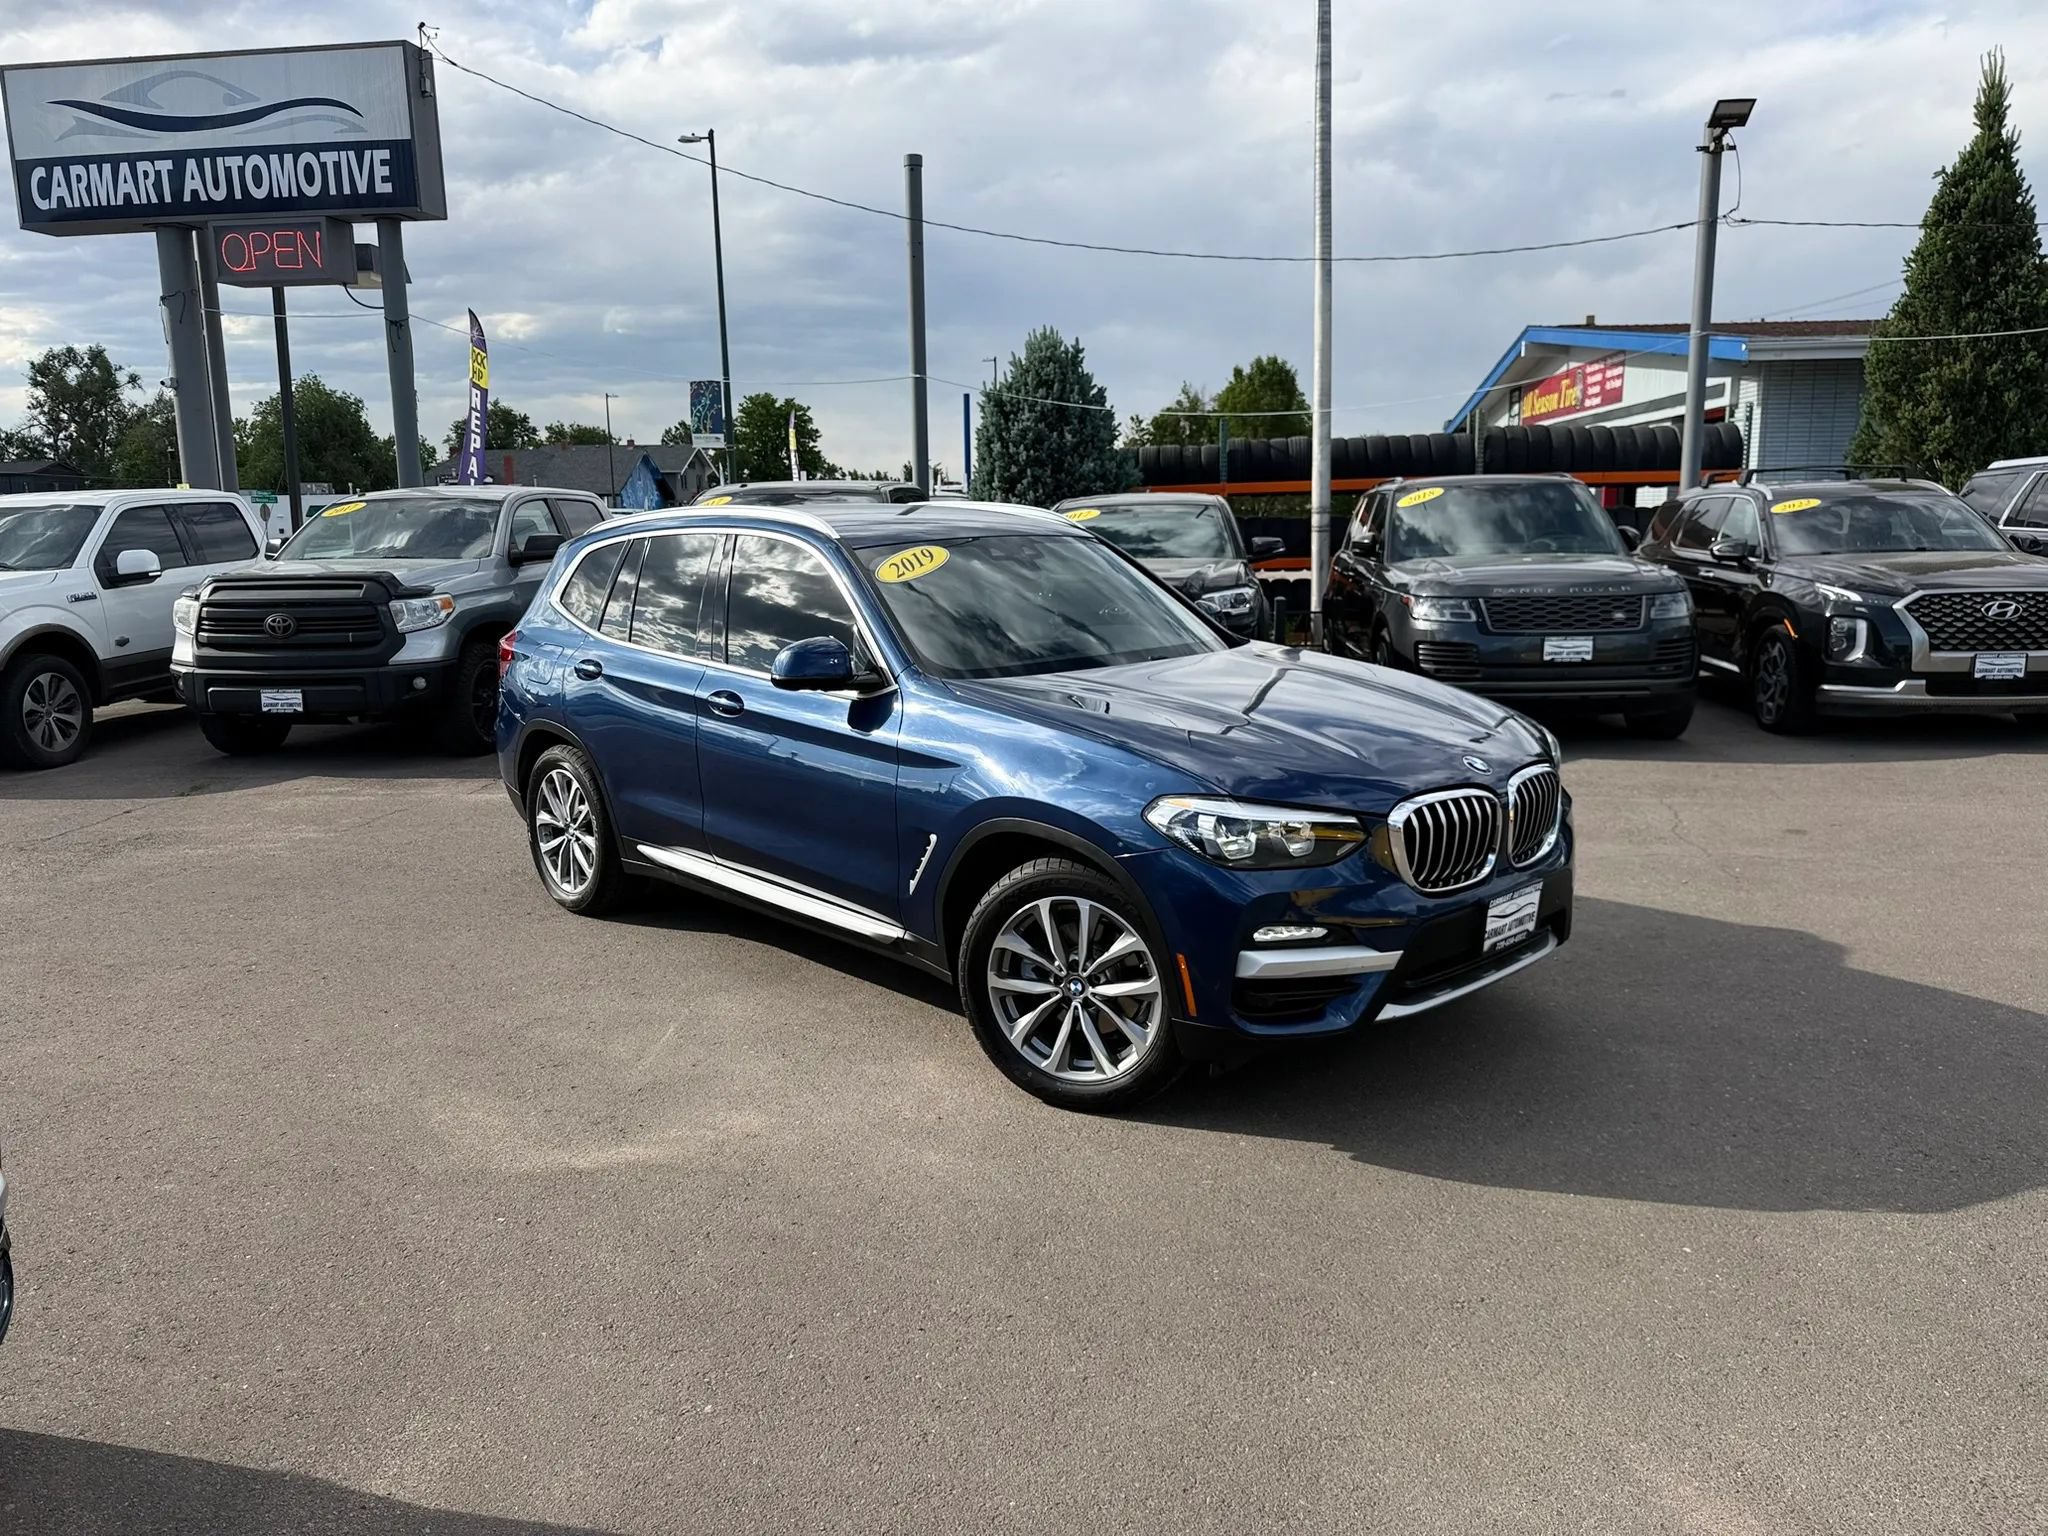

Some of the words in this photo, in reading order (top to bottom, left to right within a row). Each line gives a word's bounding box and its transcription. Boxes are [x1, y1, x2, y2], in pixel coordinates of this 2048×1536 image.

[30, 159, 173, 211] CARMART
[183, 148, 393, 202] AUTOMOTIVE
[221, 230, 323, 272] OPEN
[472, 350, 487, 370] OCK
[1532, 389, 1559, 416] Season
[1407, 490, 1436, 504] 2018
[888, 548, 935, 579] 2019
[1569, 585, 1632, 593] ROVER
[1489, 892, 1514, 908] CARMART
[1513, 881, 1543, 899] AUTOMOTIVE
[1507, 911, 1536, 932] AUTOMOTIVE
